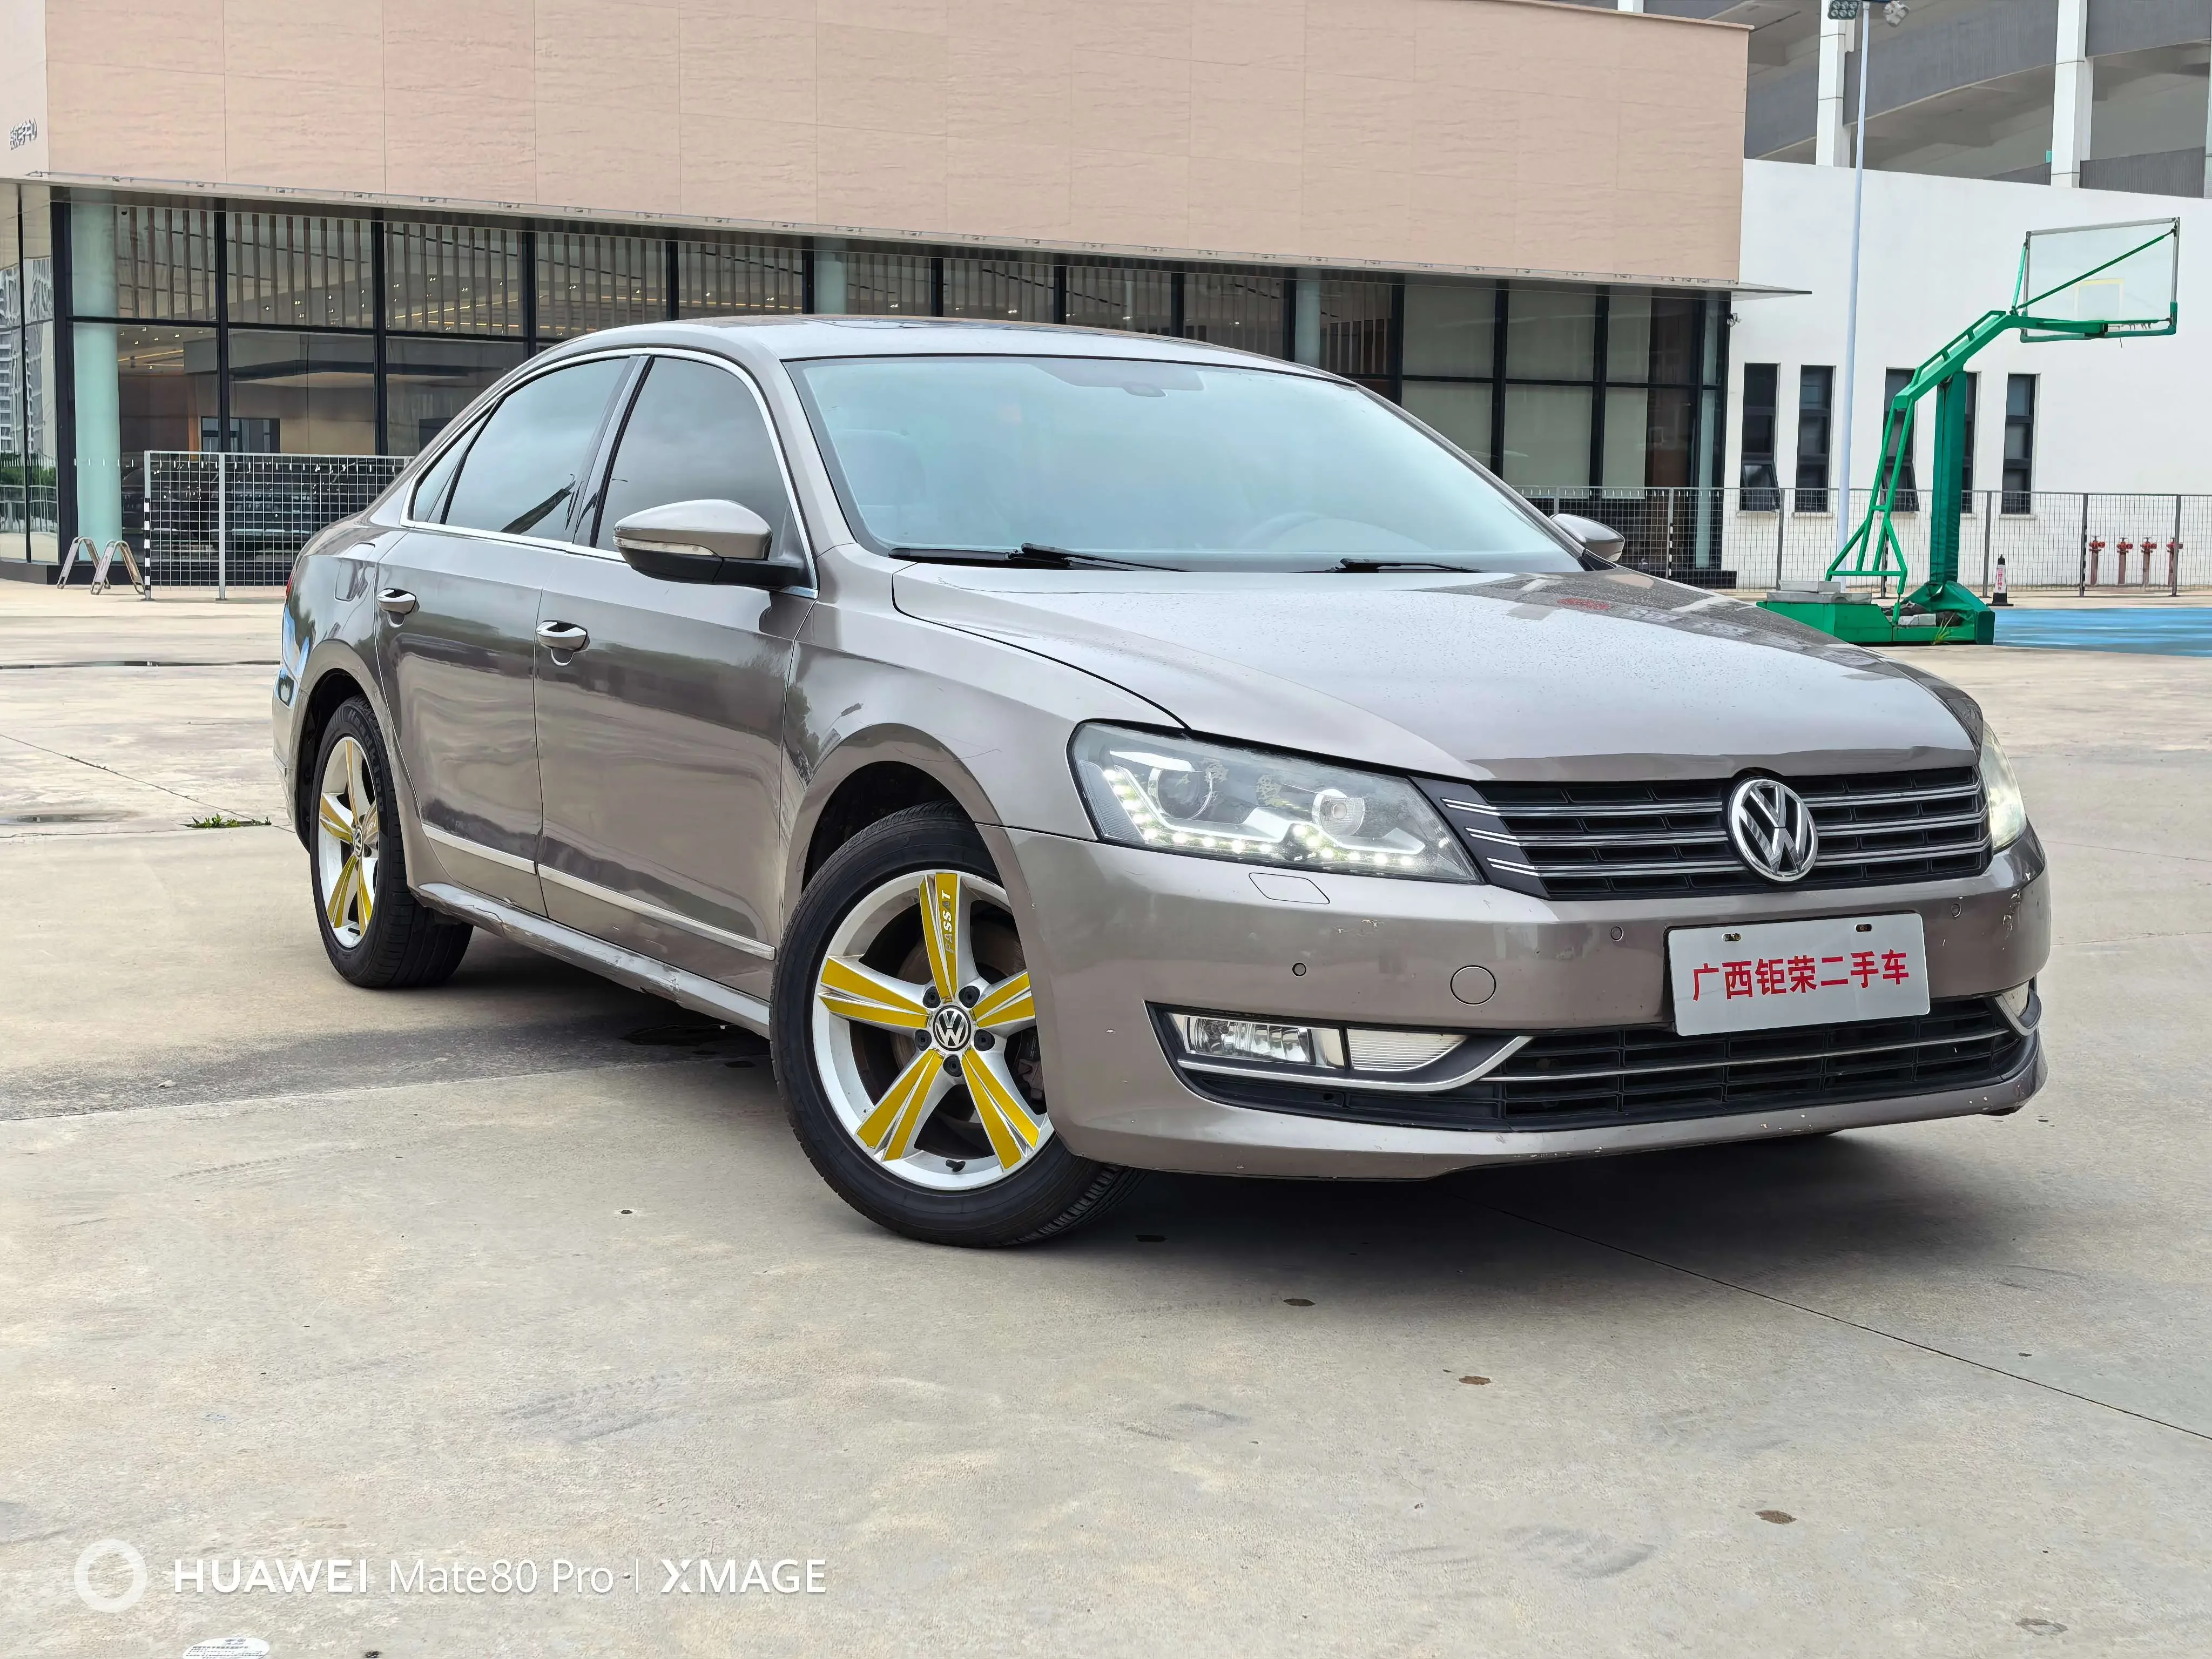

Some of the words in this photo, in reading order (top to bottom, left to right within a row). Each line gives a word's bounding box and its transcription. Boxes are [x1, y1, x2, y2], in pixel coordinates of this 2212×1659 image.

[941, 889, 954, 953] PASSAT
[1692, 948, 1910, 1002] 广西钜荣二手车
